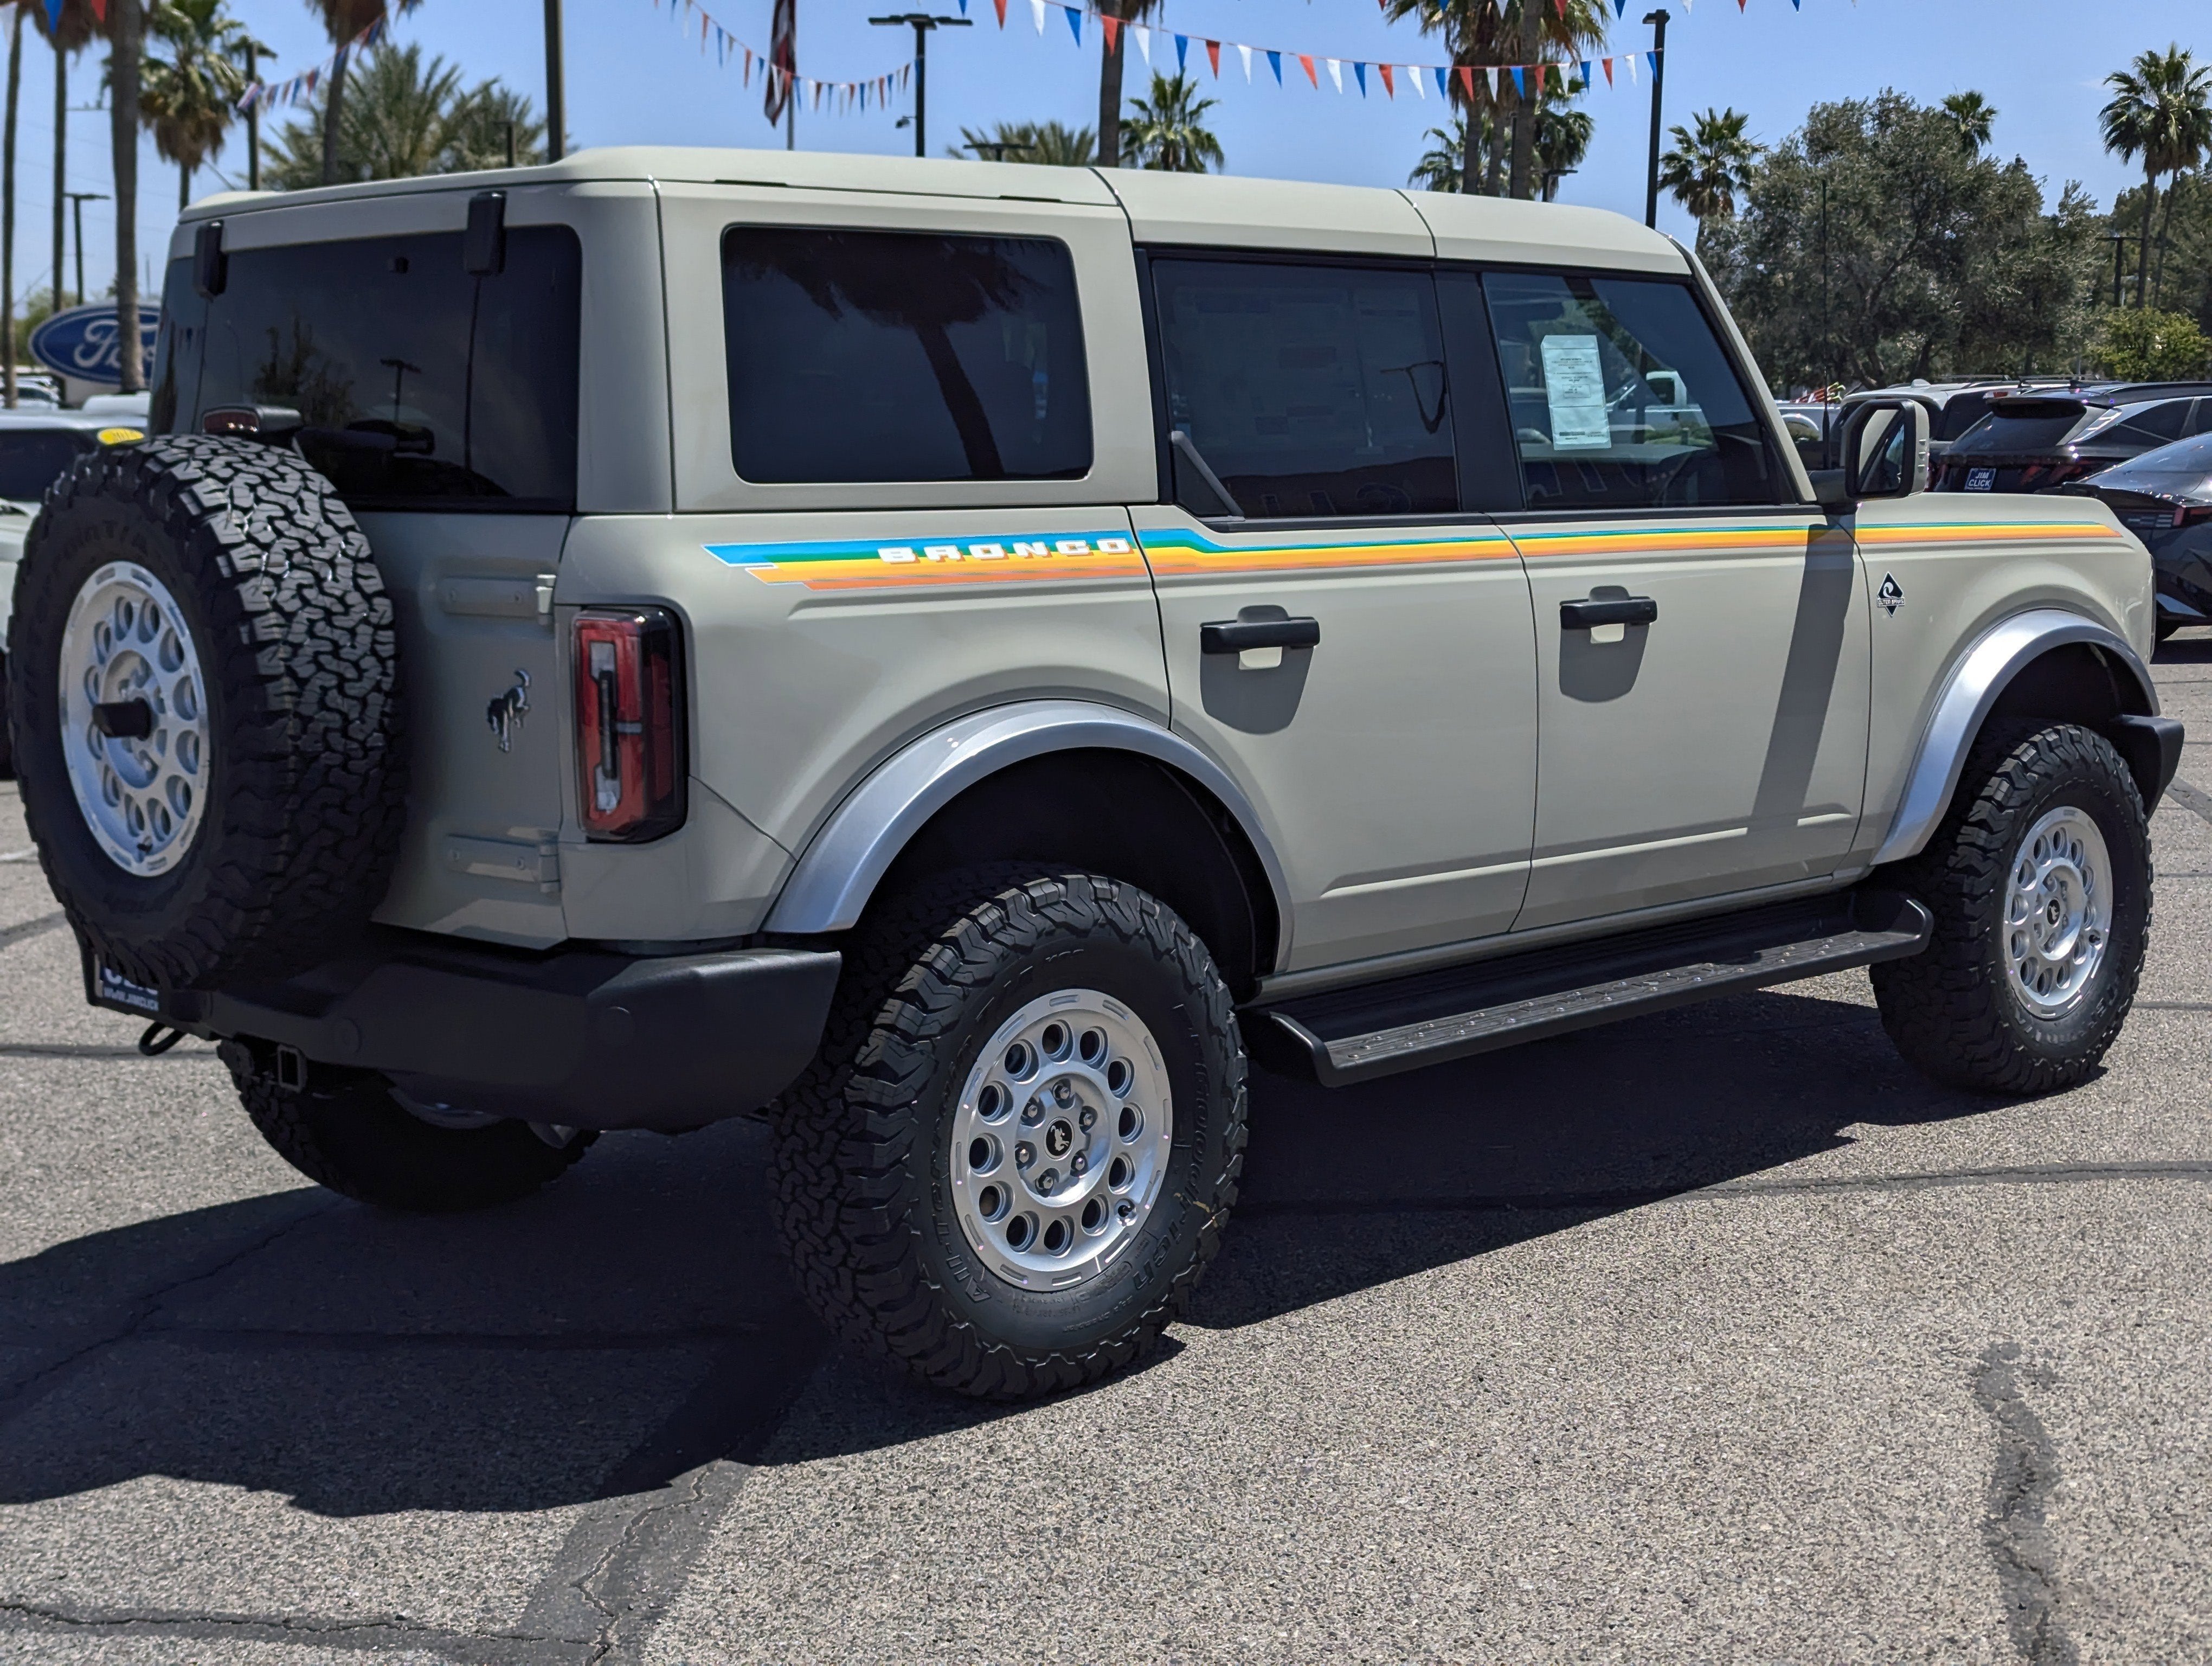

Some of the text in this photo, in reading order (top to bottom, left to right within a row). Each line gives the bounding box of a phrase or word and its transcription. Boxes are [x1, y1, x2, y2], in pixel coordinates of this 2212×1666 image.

[1975, 471, 1989, 479] JIM
[877, 538, 1133, 563] BRONCO
[1133, 1003, 1210, 1291] Goodrich
